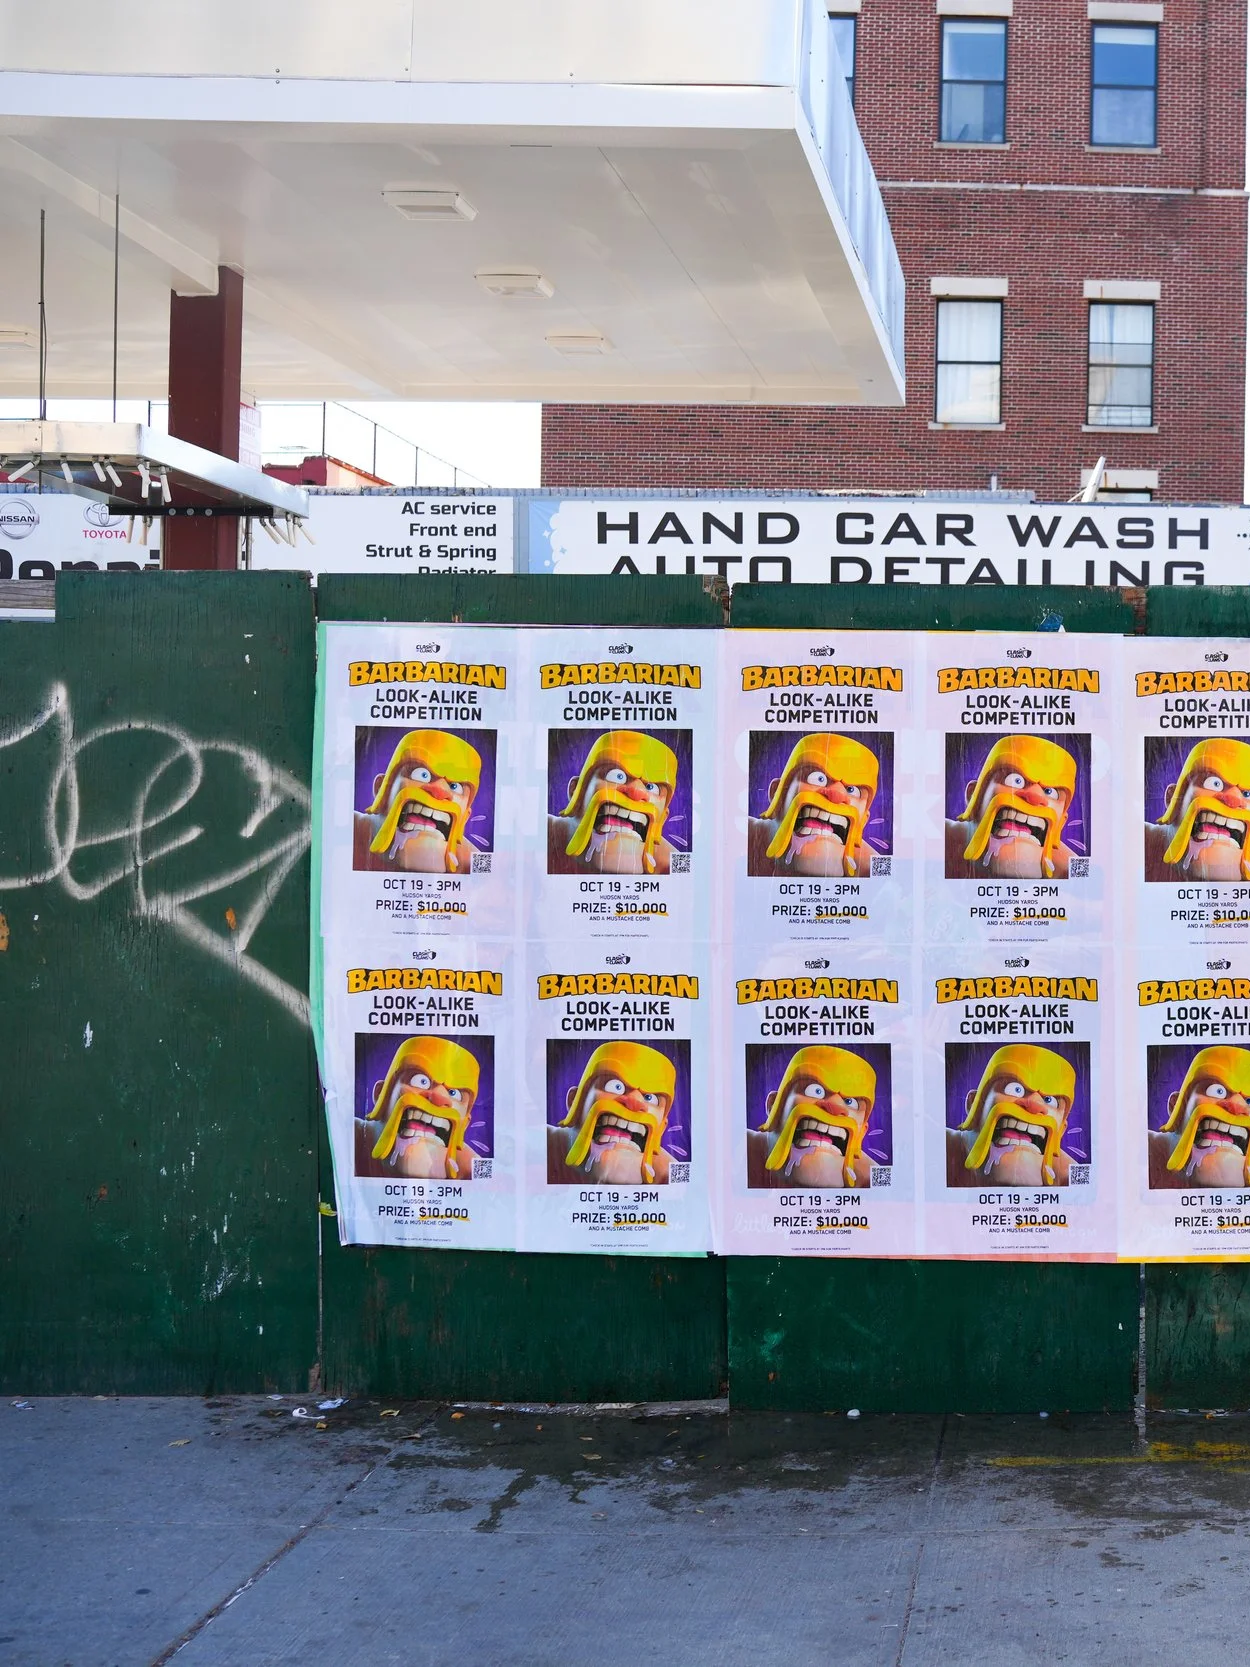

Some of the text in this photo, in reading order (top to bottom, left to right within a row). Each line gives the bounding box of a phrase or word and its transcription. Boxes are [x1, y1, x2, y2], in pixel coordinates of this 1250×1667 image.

[402, 502, 496, 514] AC service
[83, 530, 126, 538] TOYOTA
[410, 524, 496, 536] Front end
[598, 511, 1209, 550] HAND CAR WASH
[366, 545, 496, 561] Strut & Spring
[348, 661, 506, 690] BARBARIAN
[540, 662, 701, 689] BARBARIAN
[741, 665, 903, 692] BARBARIAN
[937, 667, 1100, 693] BARBARIAN
[376, 688, 477, 704] LOOK-ALIKE
[569, 690, 672, 705] LOOK-ALIKE
[770, 693, 873, 707] LOOK-ALIKE
[966, 695, 1071, 709] LOOK-ALIKE
[370, 705, 482, 721] COMPETITION
[563, 707, 677, 721] COMPETITION
[765, 709, 878, 724] COMPETITION
[961, 711, 1075, 726] COMPETITION
[779, 884, 804, 895] OCT
[808, 884, 821, 895] 19
[834, 884, 860, 895] 3PM
[376, 900, 466, 912] PRIZE: $10,000
[573, 902, 667, 915] PRIZE: $10,000
[772, 905, 866, 917] PRIZE: $10,000
[970, 906, 1066, 919] PRIZE: $10,000
[1171, 910, 1209, 921] PRIZE:
[347, 968, 502, 996] BARBARIAN
[537, 973, 699, 1000] BARBARIAN
[736, 977, 899, 1005] BARBARIAN
[935, 976, 1098, 1004] BARBARIAN
[374, 995, 474, 1011] LOOK-ALIKE
[567, 1001, 670, 1015] LOOK-ALIKE
[765, 1005, 869, 1019] LOOK-ALIKE
[965, 1004, 1069, 1018] LOOK-ALIKE
[368, 1012, 479, 1027] COMPETITION
[561, 1017, 674, 1032] COMPETITION
[760, 1022, 874, 1036] COMPETITION
[960, 1020, 1074, 1035] COMPETITION
[580, 1191, 603, 1202] OCT
[607, 1192, 619, 1203] 19
[633, 1192, 659, 1203] 3PM
[1181, 1195, 1205, 1206] OCT
[1210, 1195, 1222, 1206] 19
[378, 1205, 468, 1219] PRIZE: $10,000
[573, 1212, 666, 1225] PRIZE: $10,000
[773, 1216, 812, 1227] PRIZE:
[816, 1215, 868, 1228] $10,000
[972, 1214, 1066, 1227] PRIZE: $10,000
[1175, 1216, 1212, 1227] PRIZE:
